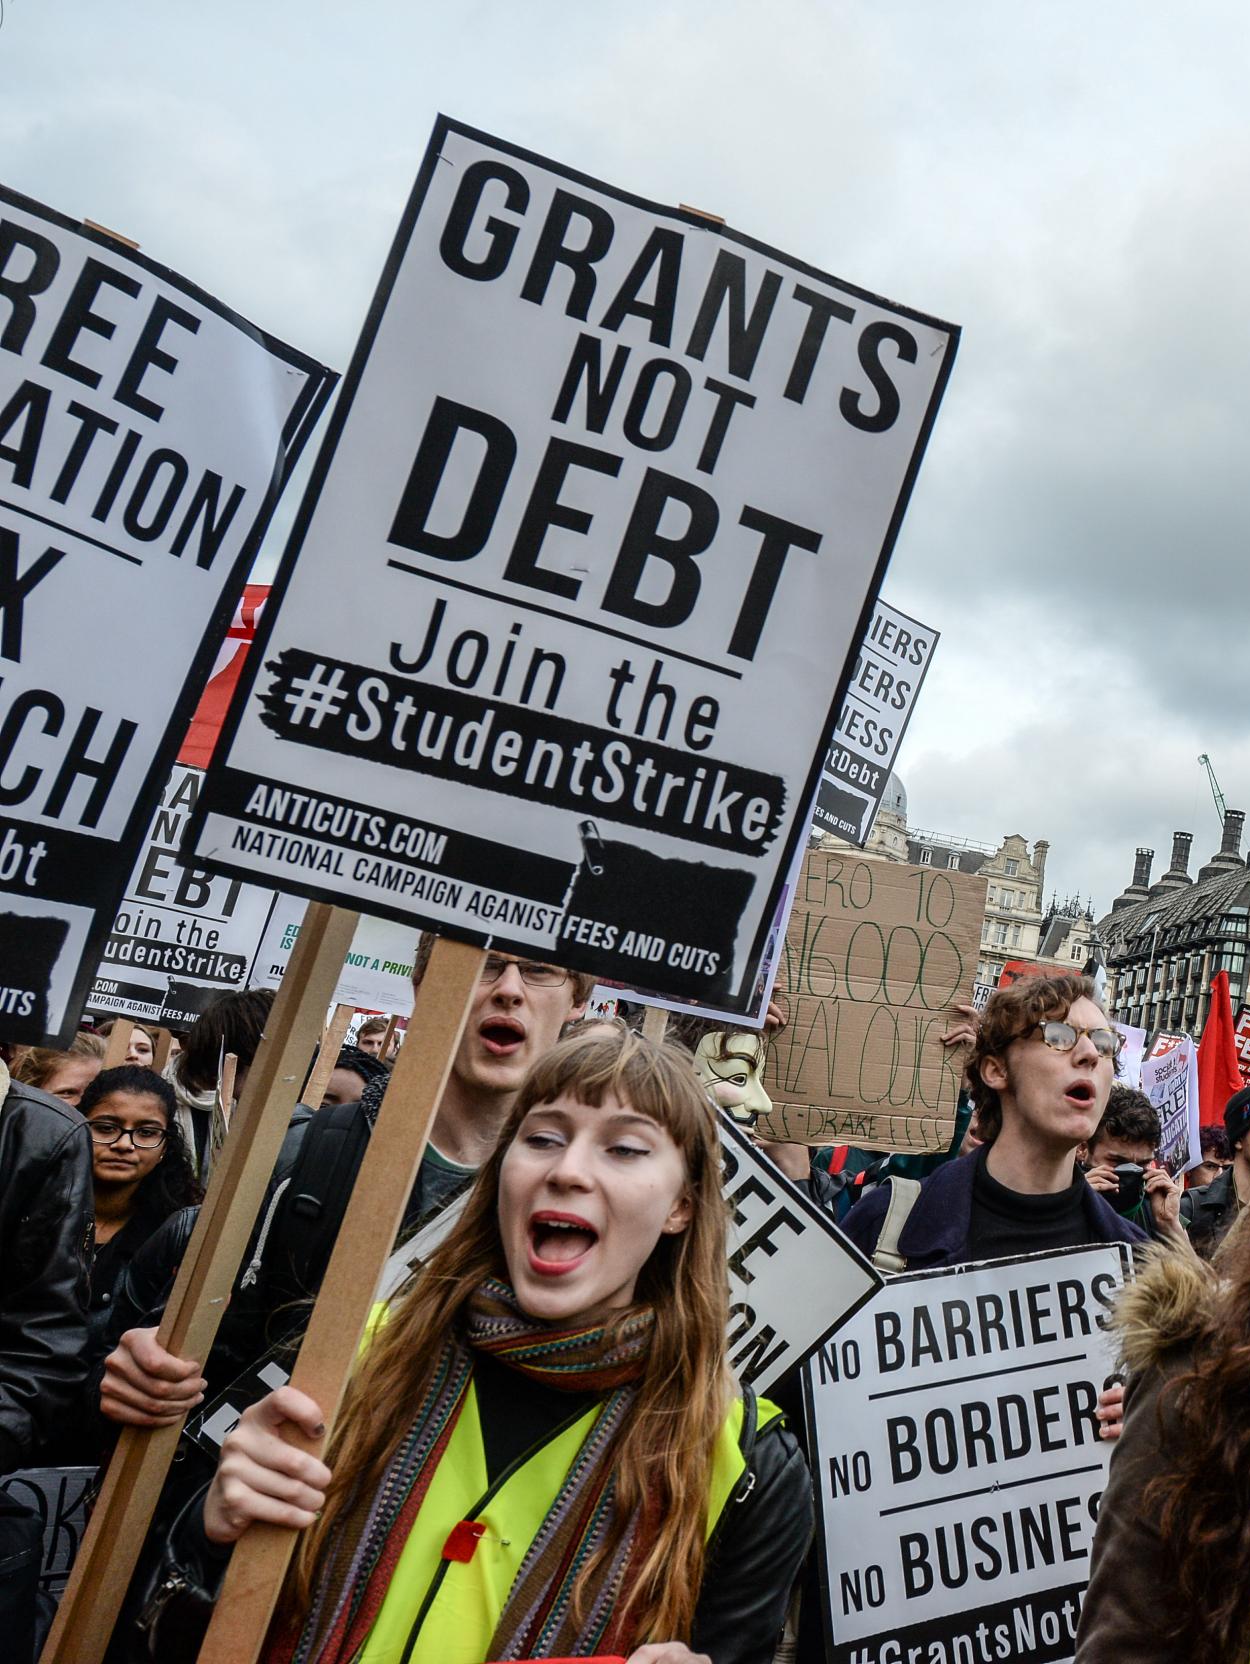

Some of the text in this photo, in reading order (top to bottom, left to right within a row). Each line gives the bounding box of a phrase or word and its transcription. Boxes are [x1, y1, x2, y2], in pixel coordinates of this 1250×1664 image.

[439, 160, 918, 434] GRANTS
[551, 332, 757, 475] NOT
[387, 396, 823, 662] DEBT
[389, 598, 720, 752] Join the
[0, 676, 139, 829] CH
[289, 663, 773, 844] #StudentStrike
[827, 747, 880, 790] tDebt
[246, 784, 448, 866] ANTICUTS.COM
[824, 812, 838, 826] AND
[839, 816, 857, 835] CUTS
[176, 919, 220, 950] the
[232, 825, 720, 976] NATIONAL CAMPAIGN AGANIST FEES AND CUTS
[909, 869, 955, 928] TO
[126, 1001, 162, 1016] AGANIST
[162, 1009, 183, 1021] FEES
[345, 953, 370, 968] NOT
[371, 959, 379, 971] A
[818, 1272, 1117, 1385] NO BARRIERS
[829, 1373, 1126, 1498] NO BORDER
[840, 1564, 885, 1615] NO
